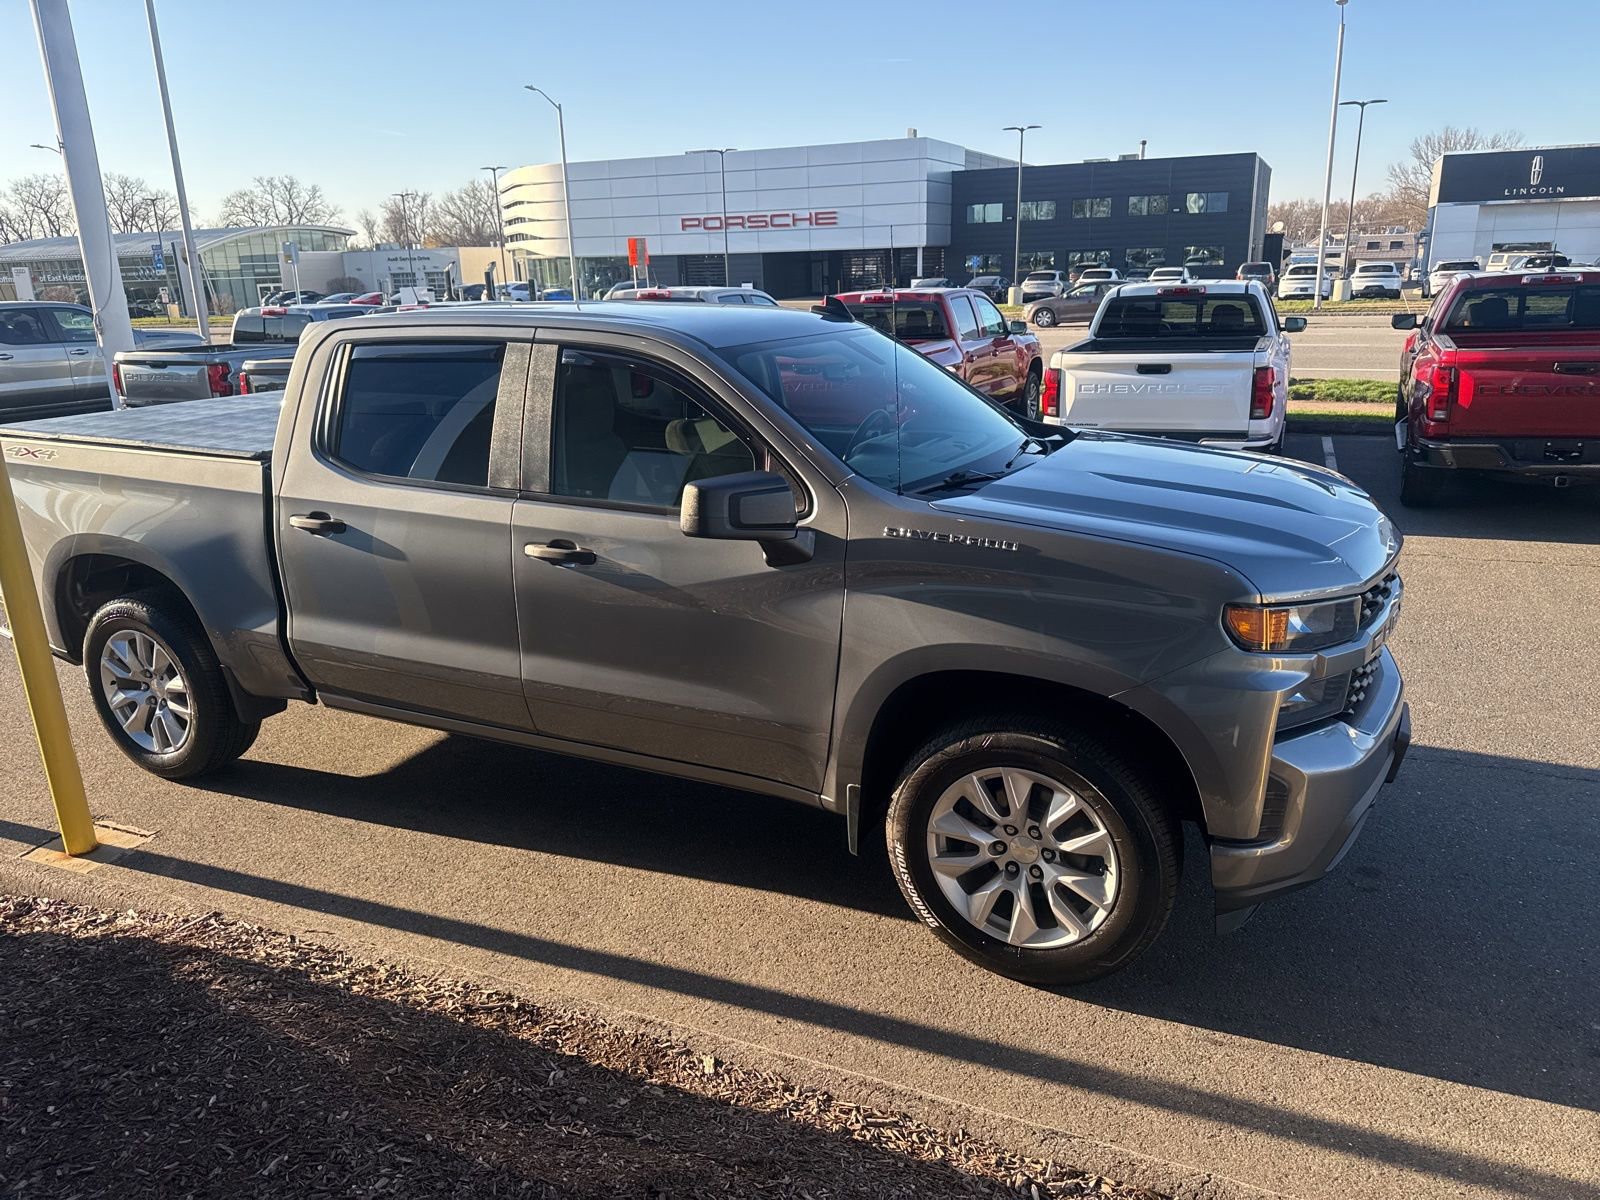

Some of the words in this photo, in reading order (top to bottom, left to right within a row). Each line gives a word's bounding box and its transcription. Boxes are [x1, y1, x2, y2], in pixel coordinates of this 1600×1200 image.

[1504, 186, 1564, 196] LINCOLN
[681, 211, 839, 231] PORSCHE
[47, 274, 61, 283] East
[62, 273, 86, 282] Hartfo
[1078, 383, 1233, 394] CHEVROLET
[882, 526, 1019, 551] SILVERADO
[894, 839, 940, 928] BRIDGESTONE
